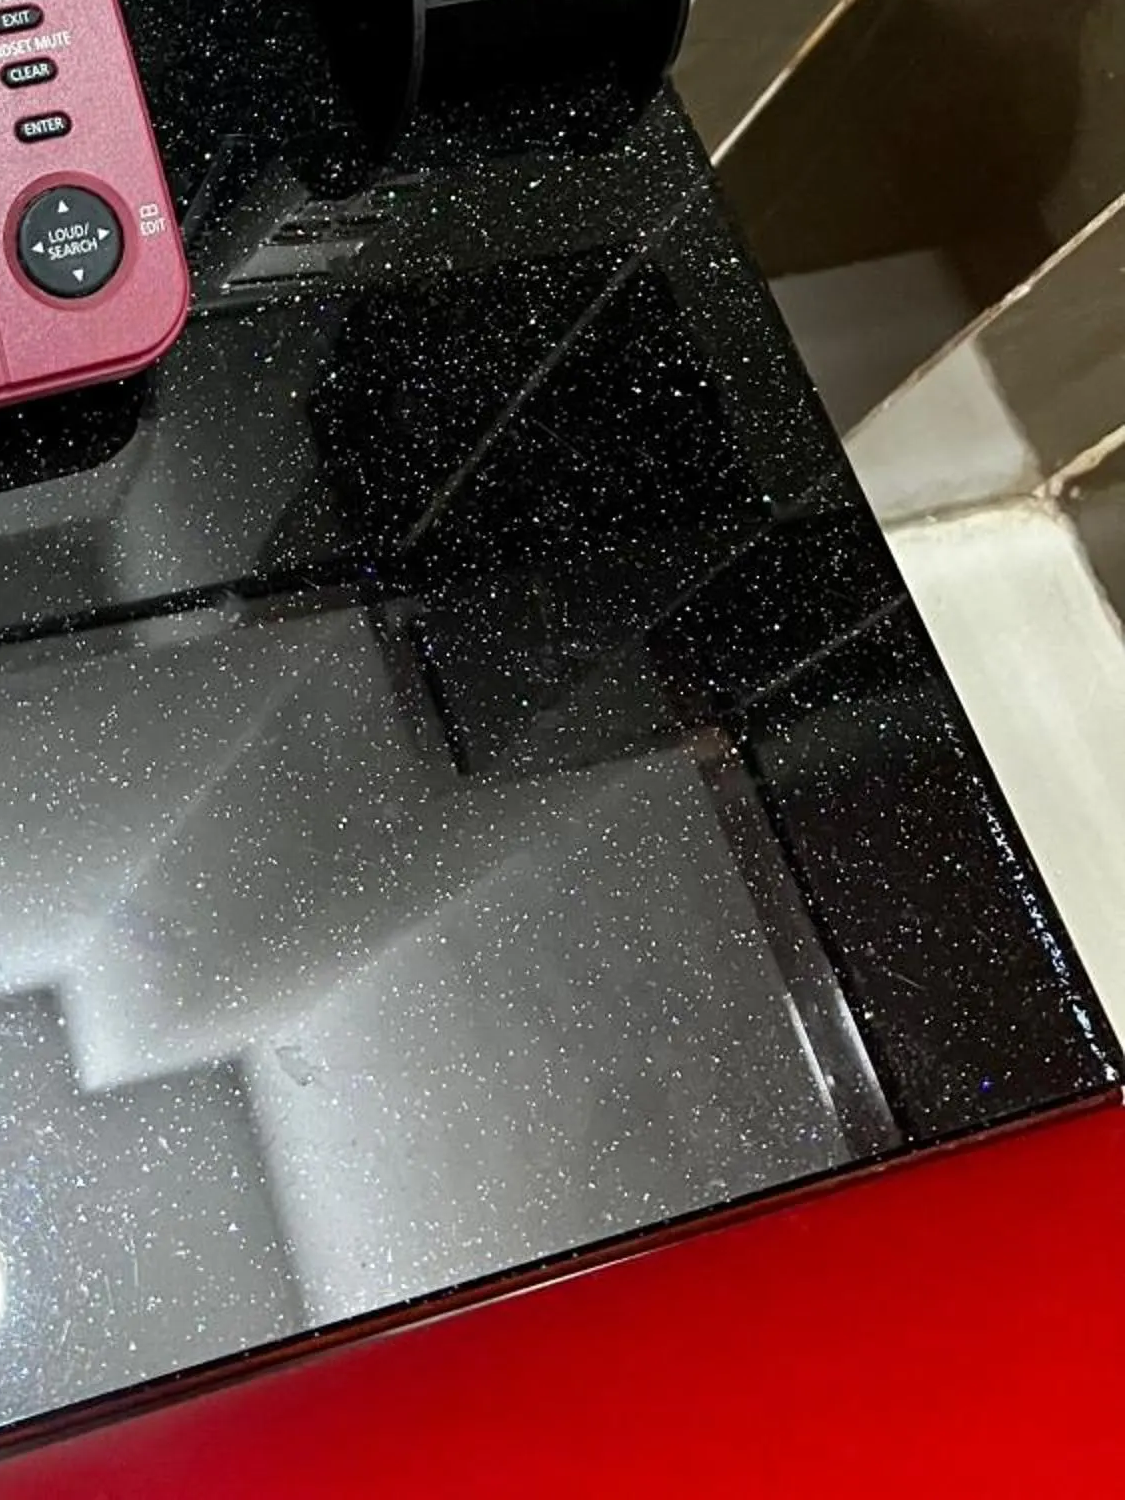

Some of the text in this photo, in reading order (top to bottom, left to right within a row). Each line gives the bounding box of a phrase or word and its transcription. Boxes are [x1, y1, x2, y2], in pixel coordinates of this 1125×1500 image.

[1, 9, 30, 27] EXIT
[34, 30, 71, 51] MUTE
[10, 63, 49, 82] CLEAR
[24, 118, 64, 136] ENTER
[48, 222, 89, 243] LOUD/
[140, 218, 166, 236] EDIT
[48, 238, 98, 261] SEARCH
